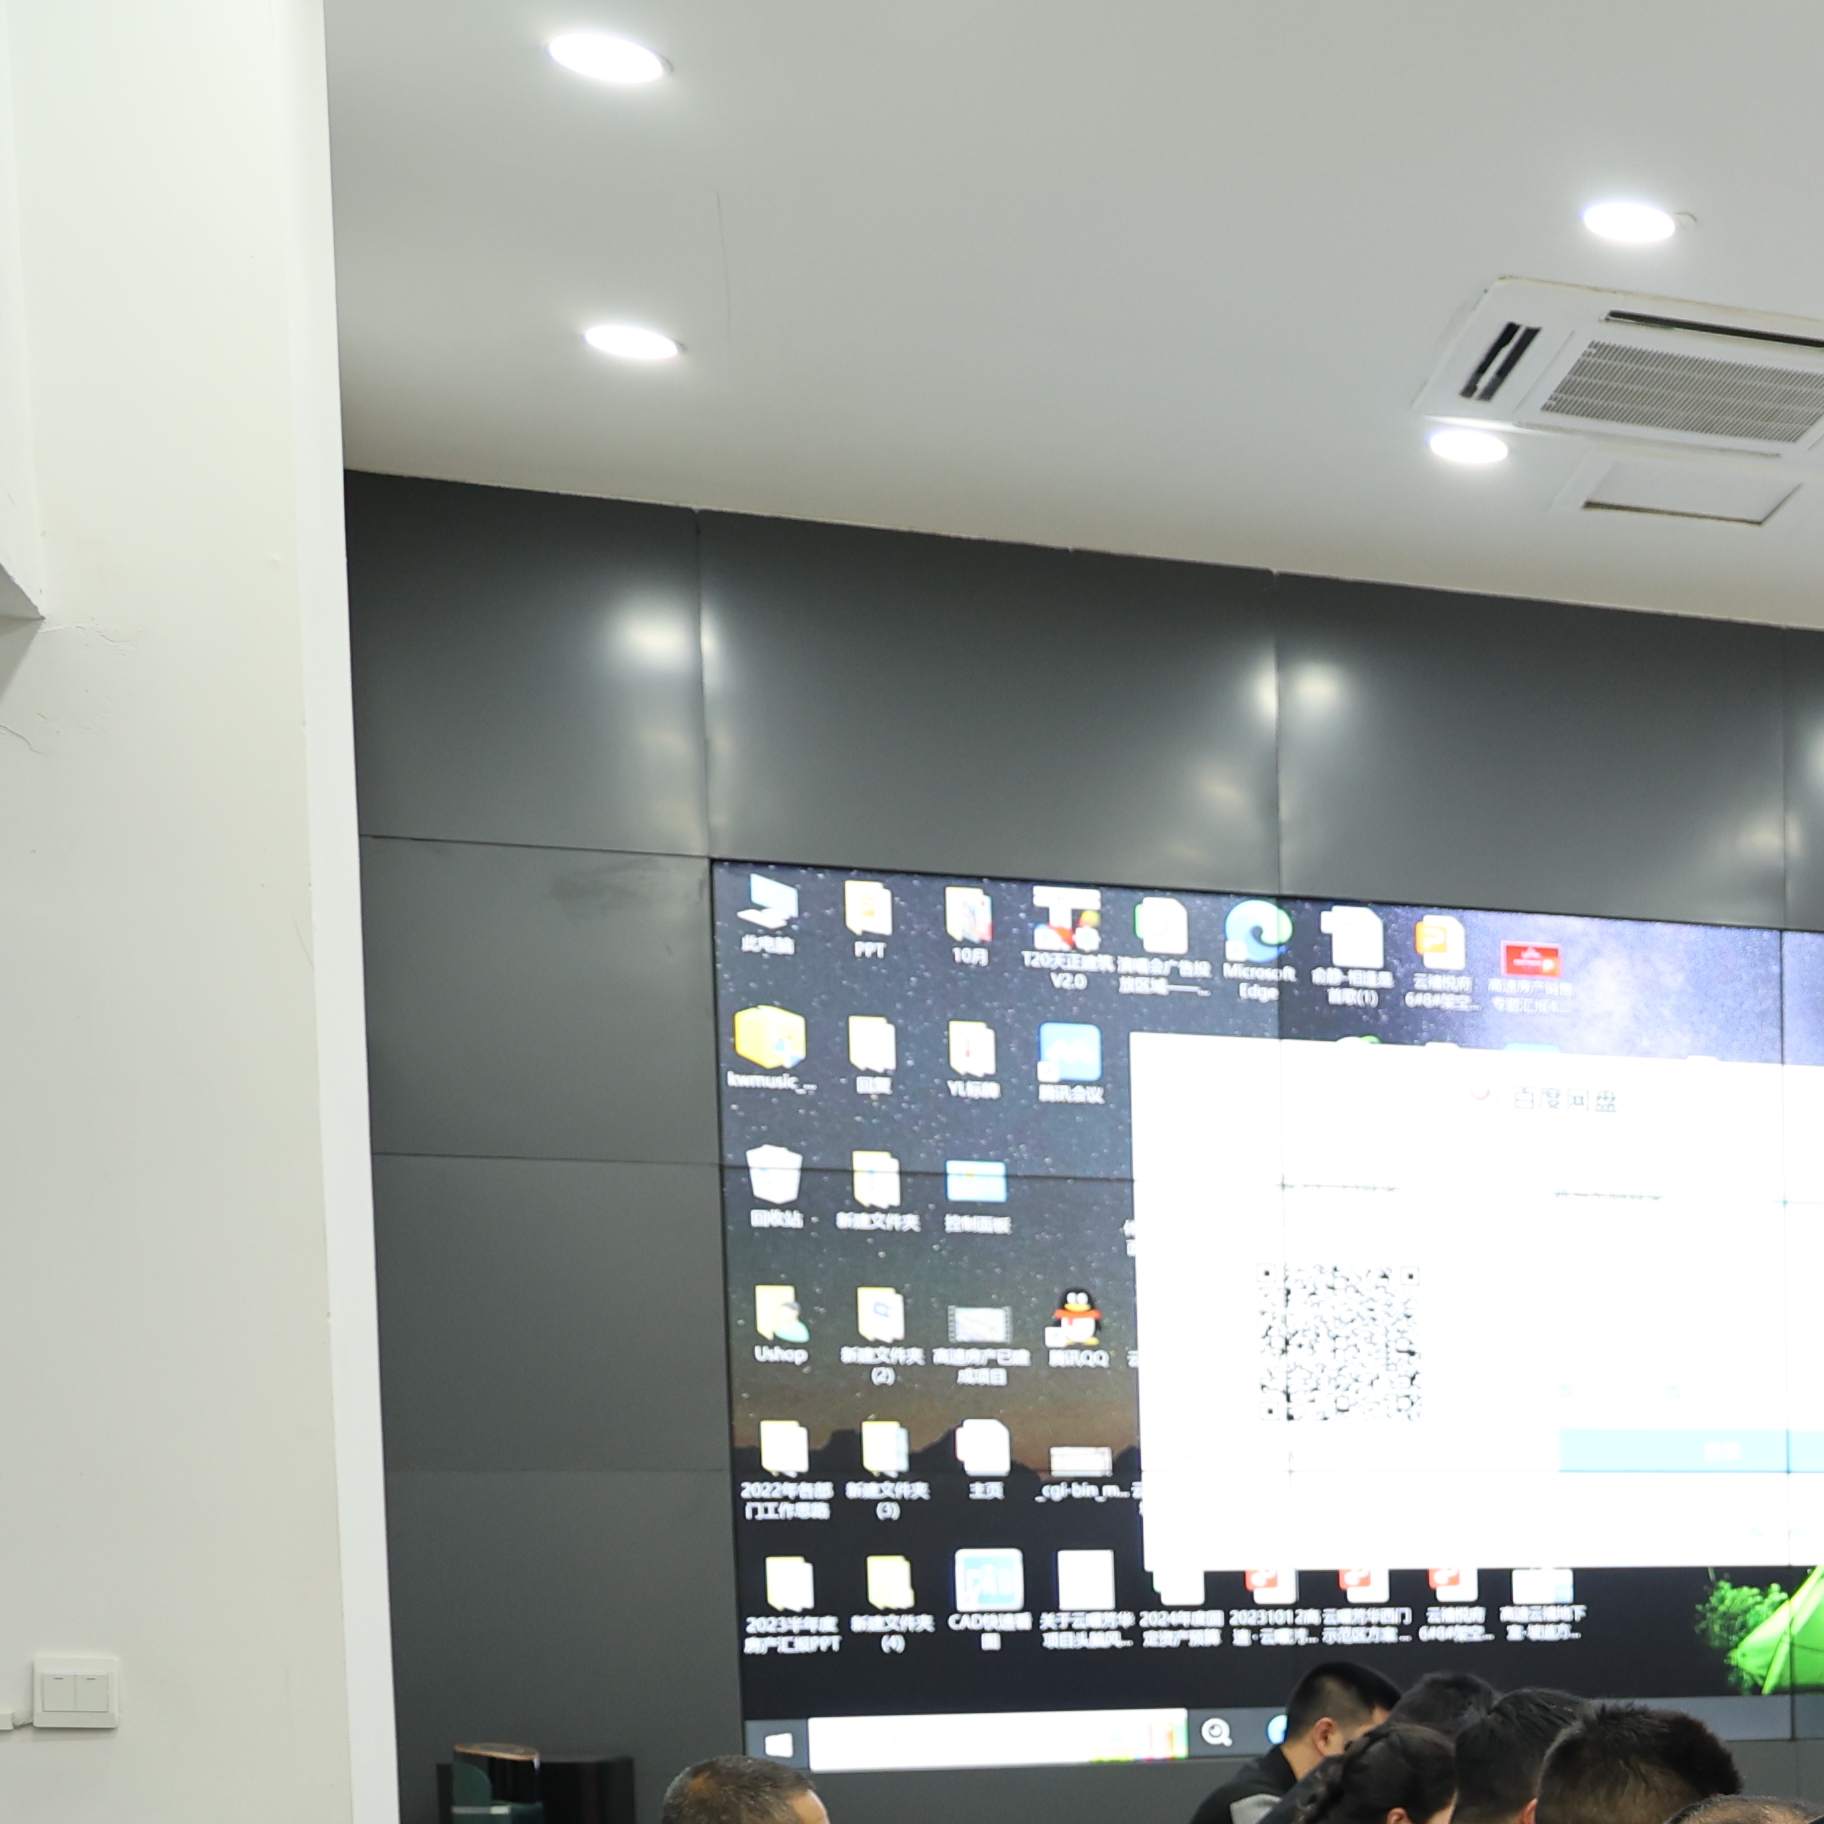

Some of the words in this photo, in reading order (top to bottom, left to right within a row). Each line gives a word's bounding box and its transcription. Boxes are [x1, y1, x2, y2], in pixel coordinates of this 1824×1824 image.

[741, 934, 795, 955] 此电脑
[854, 941, 886, 958] PPT
[952, 947, 989, 966] 10月
[1050, 972, 1088, 990] V2.0
[1223, 962, 1297, 982] Microsoft
[1239, 983, 1279, 1002] Edge
[1038, 1084, 1105, 1105] 腾讯会议
[751, 1210, 804, 1229] 回收站
[836, 1212, 921, 1233] 新建文件夹
[944, 1214, 1013, 1235] 控制面板
[841, 1347, 925, 1367] 新建文件夹
[932, 1347, 1031, 1368] 高速房产已建
[1048, 1347, 1110, 1369] 腾讯QQ
[870, 1367, 895, 1387] (2)
[956, 1368, 1008, 1388] 成项目
[846, 1481, 931, 1500] 新建文件夹
[969, 1482, 1005, 1500] 主页
[876, 1502, 901, 1521] (3)
[746, 1615, 839, 1634] 2023半年度
[851, 1615, 935, 1633] 新建文件夹
[881, 1635, 906, 1653] (4)
